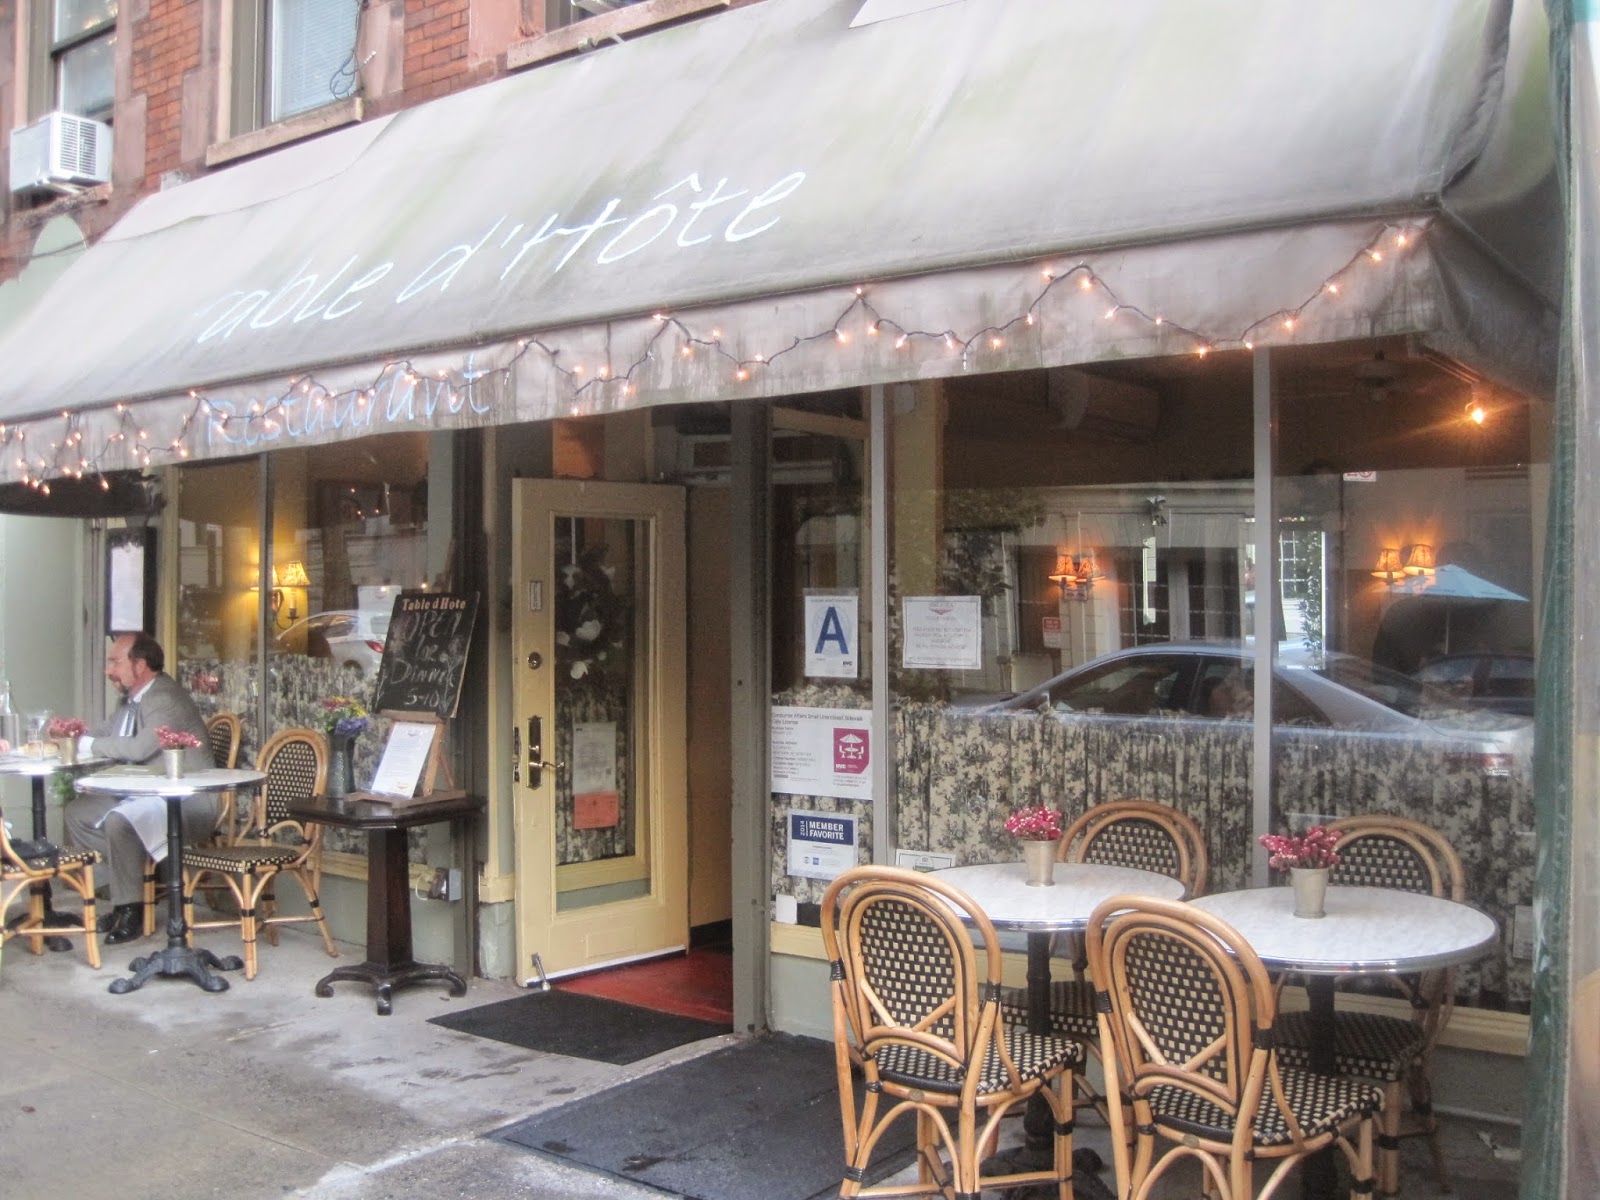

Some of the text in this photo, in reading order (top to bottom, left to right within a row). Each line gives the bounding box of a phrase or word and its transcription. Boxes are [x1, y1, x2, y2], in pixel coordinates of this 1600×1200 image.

[206, 351, 491, 446] Restaurant
[402, 598, 431, 611] Table
[814, 606, 849, 655] A
[809, 821, 844, 832] MEMBER
[809, 829, 844, 840] FAVORITE
